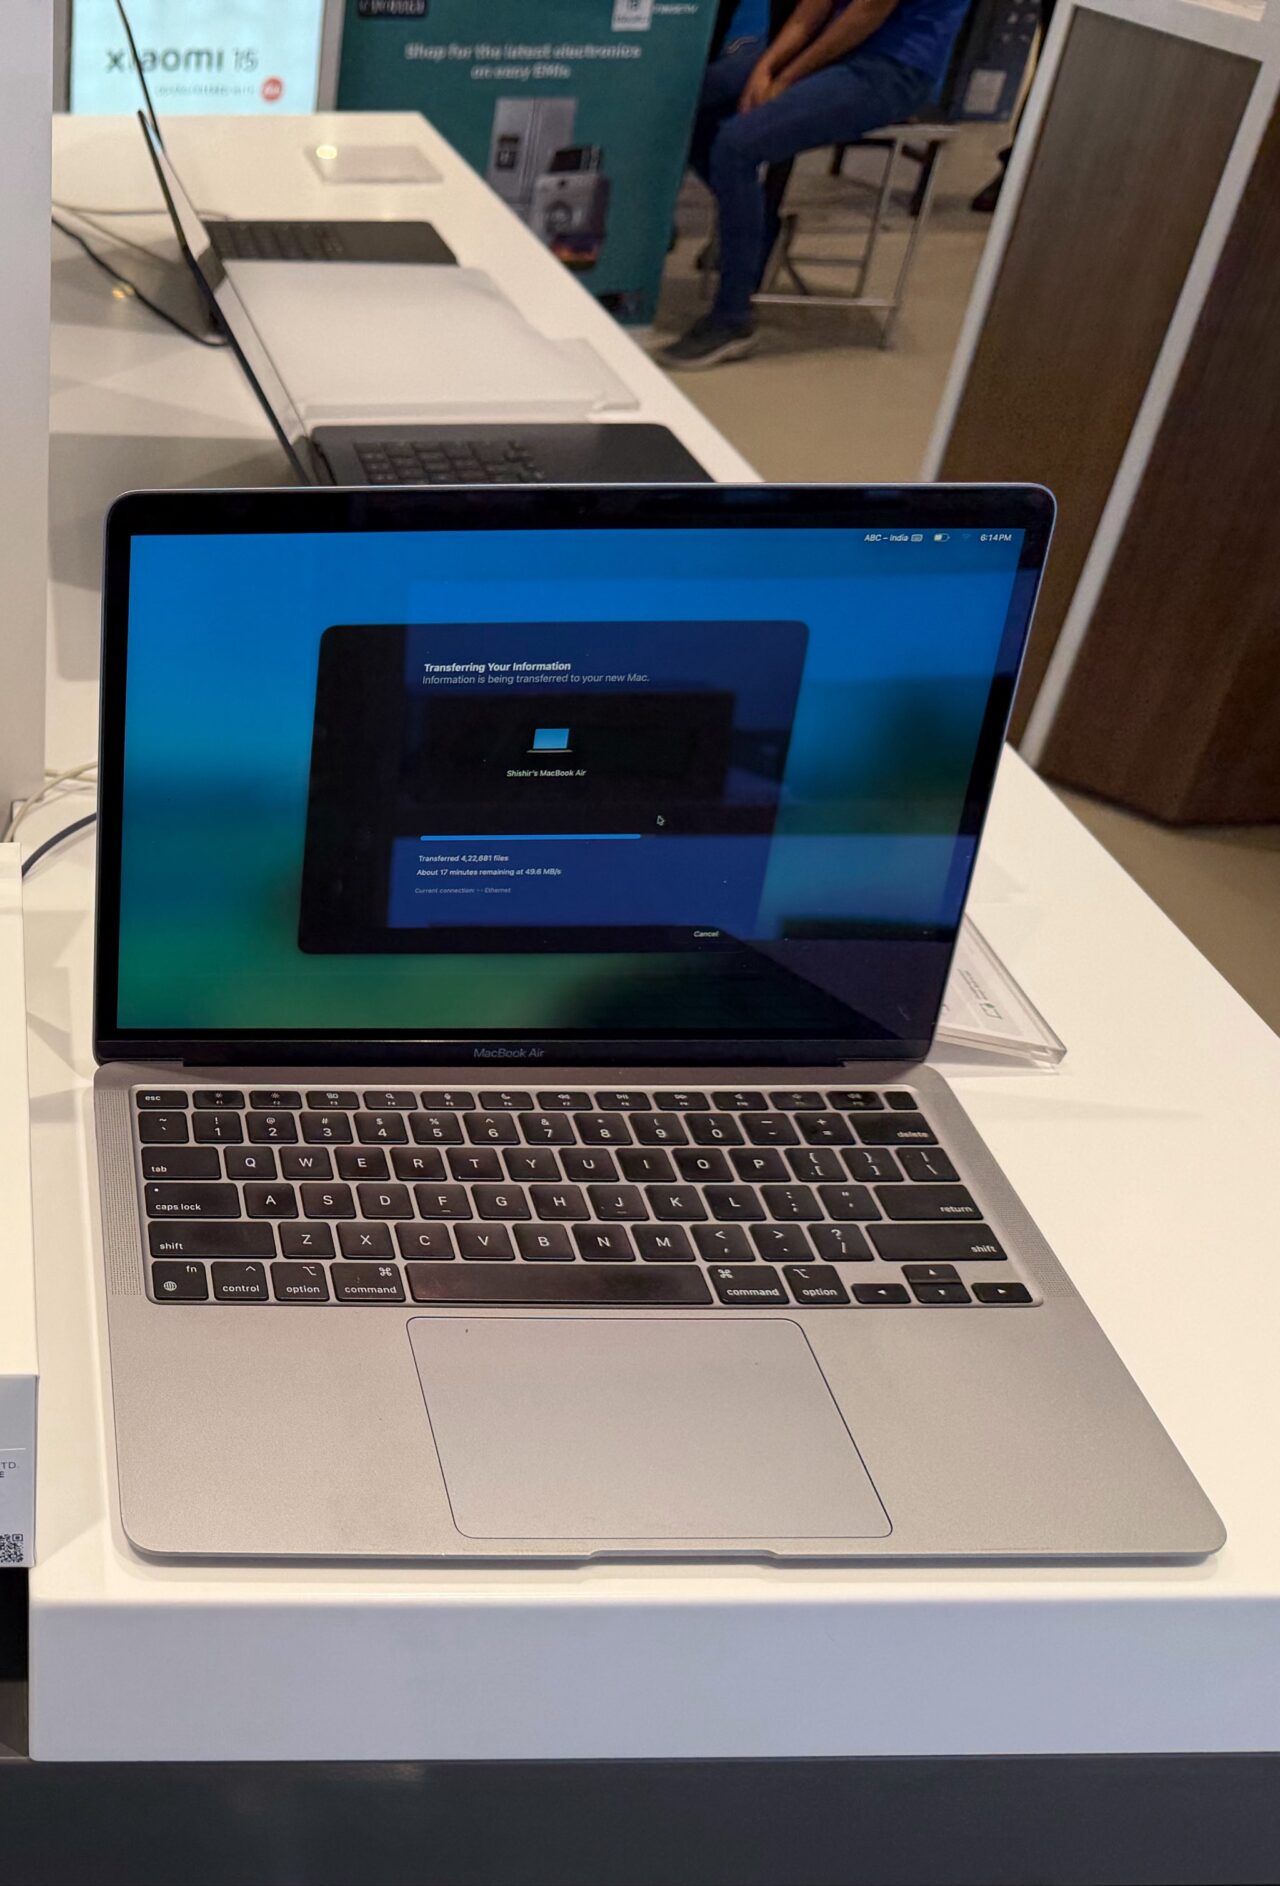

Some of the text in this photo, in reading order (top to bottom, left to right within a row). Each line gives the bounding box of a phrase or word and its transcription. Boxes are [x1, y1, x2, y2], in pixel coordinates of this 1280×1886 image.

[864, 534, 881, 542] ABC
[424, 662, 571, 673] Transferring Your Information
[422, 675, 476, 684] Information
[478, 675, 485, 684] is
[488, 675, 514, 685] being
[516, 674, 569, 683] transferred
[582, 675, 603, 685] your
[627, 673, 650, 682] Mac.
[460, 855, 492, 863] 4,22,681
[473, 1048, 545, 1058] MacBook Air
[151, 1165, 167, 1173] tab
[155, 1202, 202, 1213] caps lock
[940, 1205, 973, 1214] return
[159, 1241, 184, 1251] shift
[971, 1244, 997, 1254] shift
[186, 1265, 198, 1273] fn
[222, 1284, 259, 1293] control
[286, 1285, 320, 1295] option
[344, 1284, 397, 1294] command
[726, 1287, 779, 1298] command
[803, 1287, 838, 1298] option
